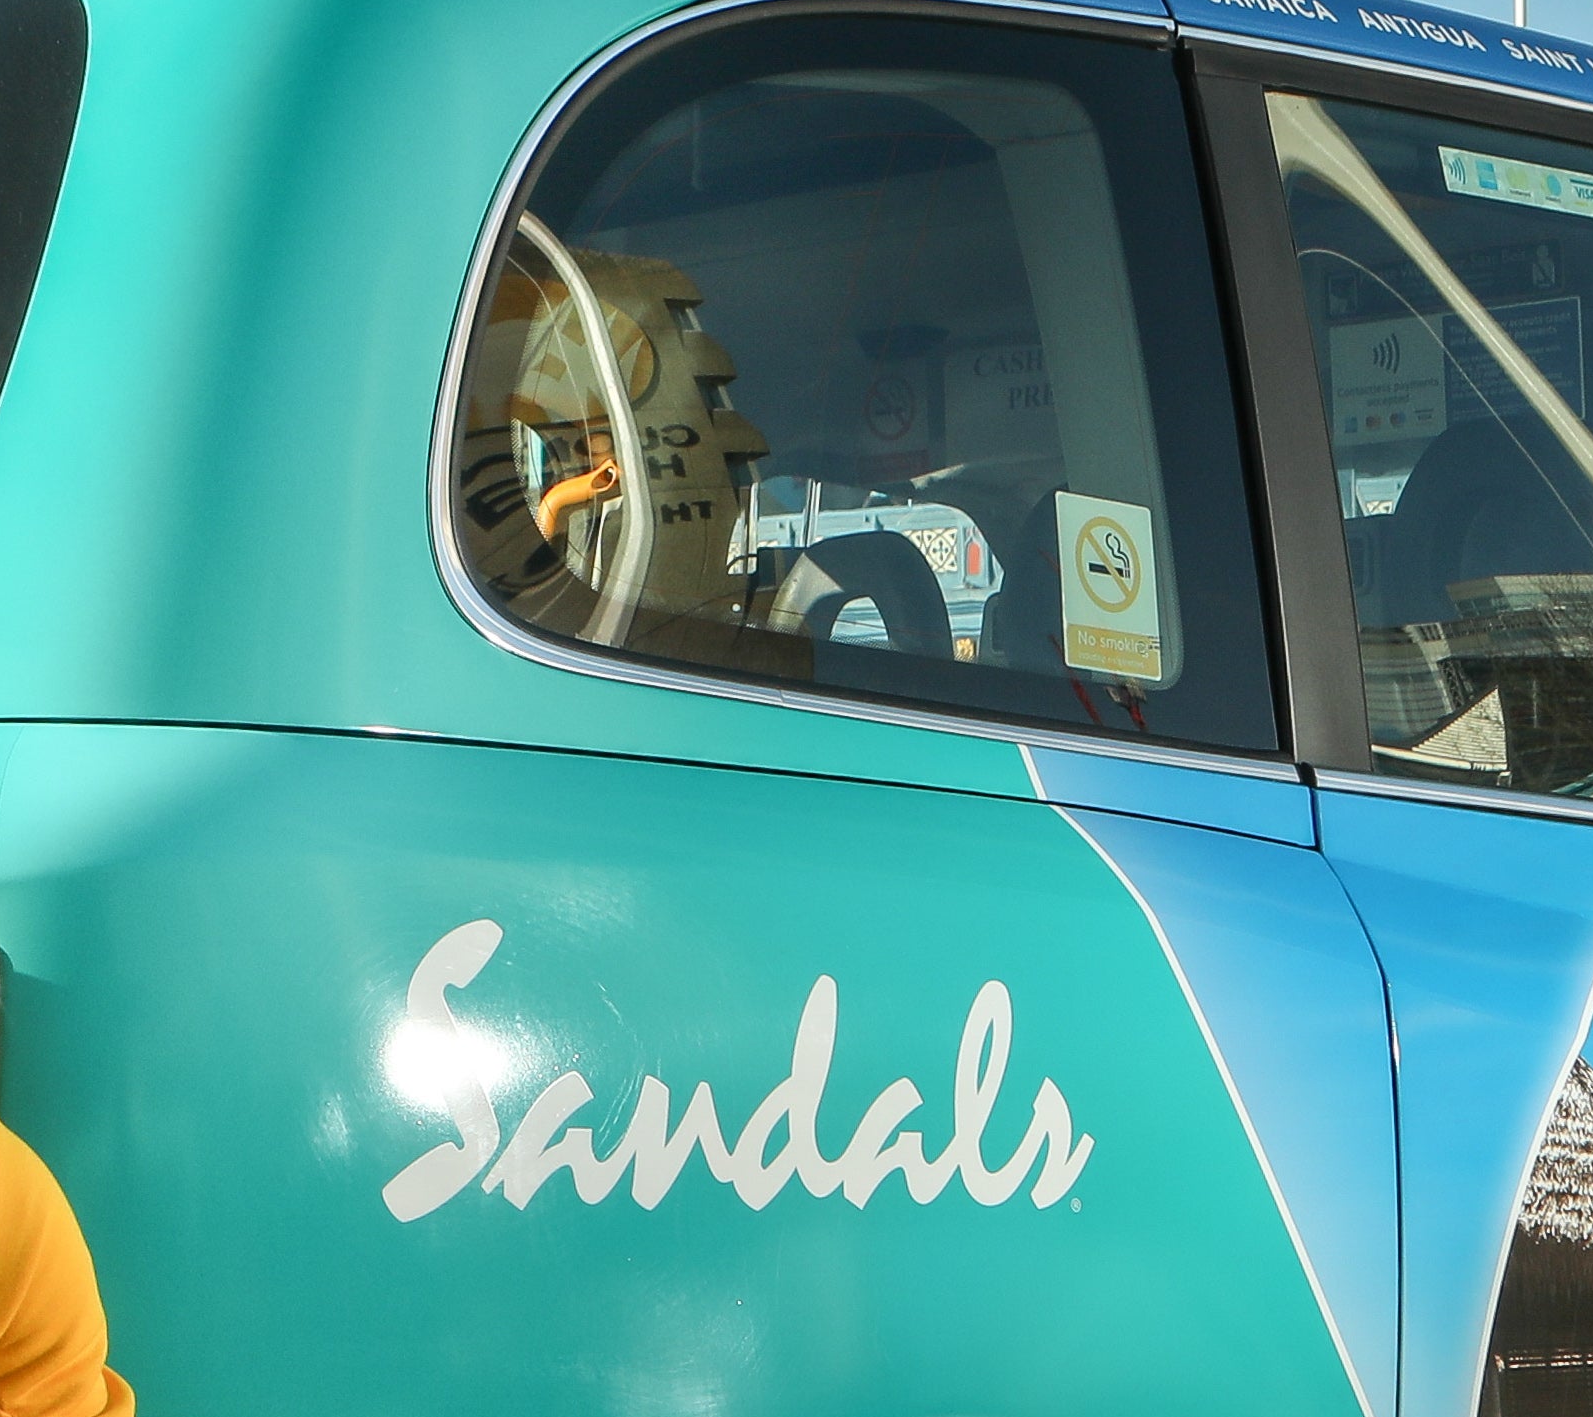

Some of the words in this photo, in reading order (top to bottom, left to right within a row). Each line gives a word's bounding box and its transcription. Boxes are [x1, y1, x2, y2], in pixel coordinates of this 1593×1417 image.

[1357, 8, 1488, 53] ANTIGUA
[1501, 38, 1586, 74] SAINT
[1077, 630, 1096, 646] No
[1100, 636, 1151, 659] smoking
[382, 918, 1095, 1224] Sandals
